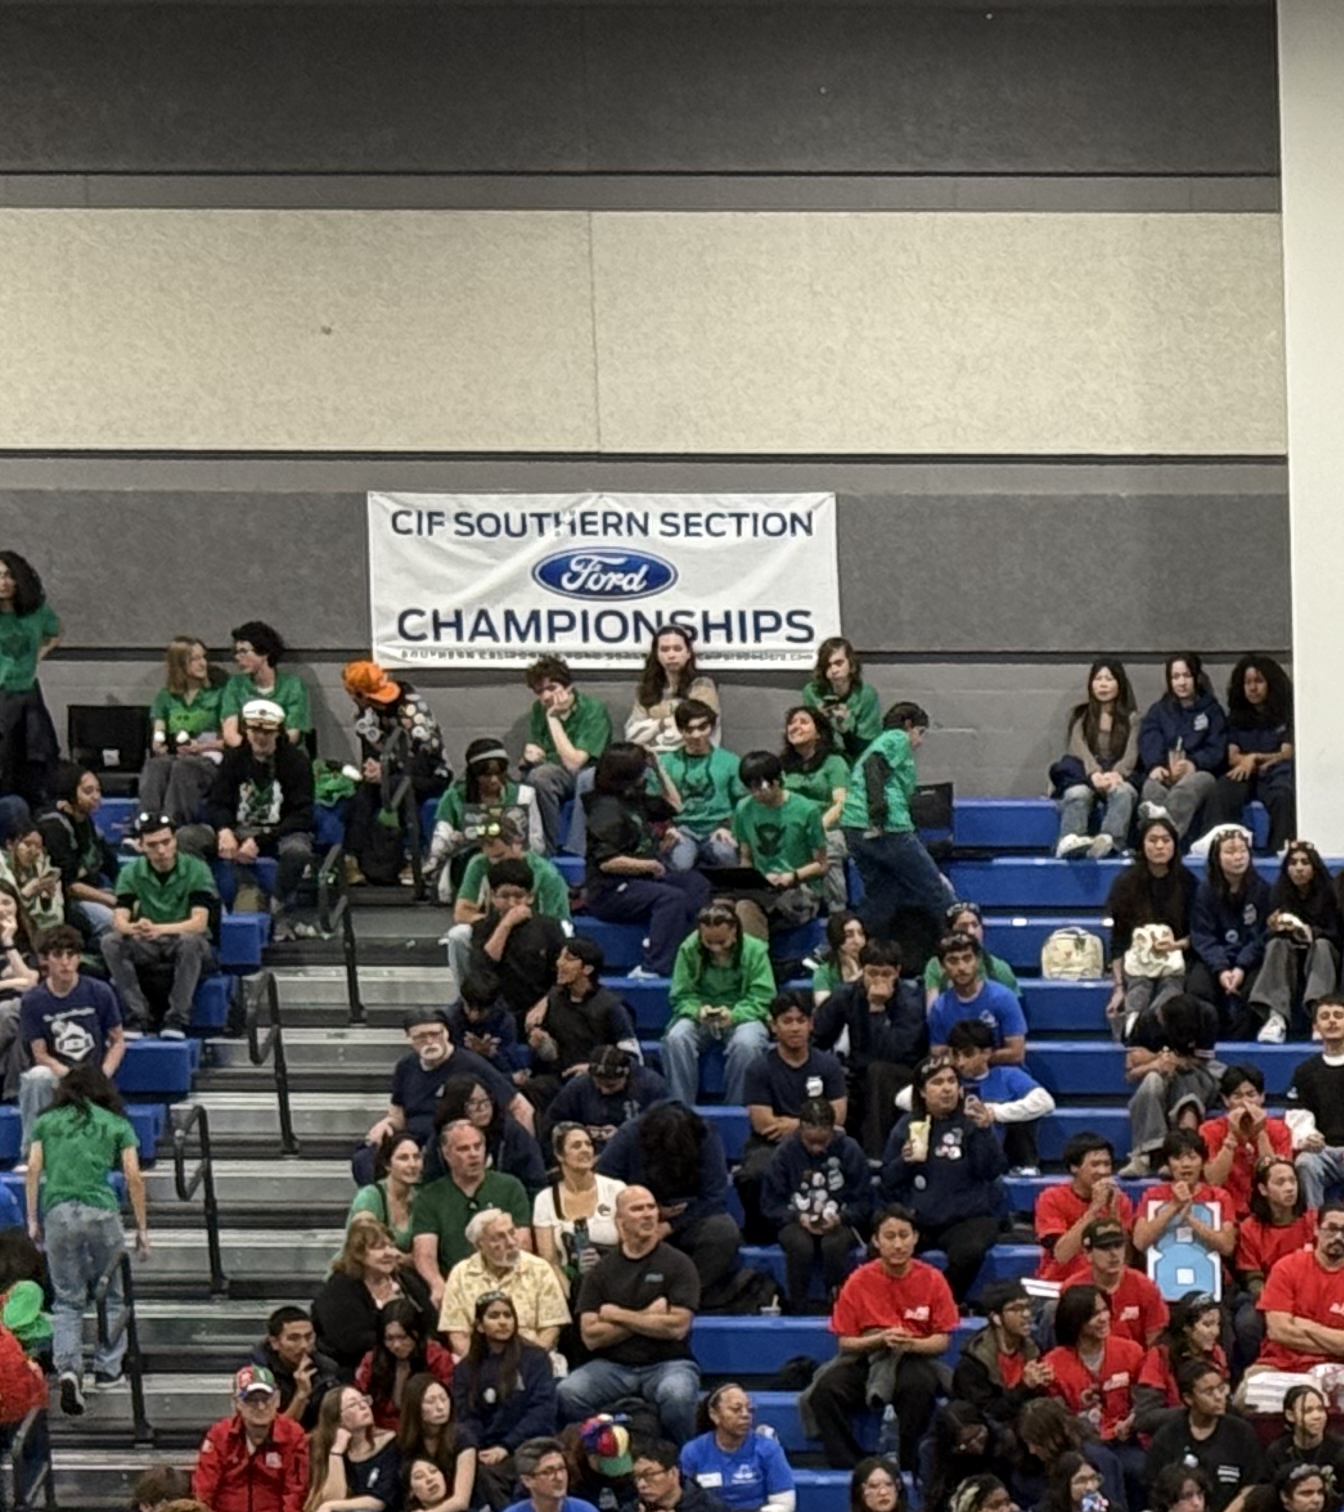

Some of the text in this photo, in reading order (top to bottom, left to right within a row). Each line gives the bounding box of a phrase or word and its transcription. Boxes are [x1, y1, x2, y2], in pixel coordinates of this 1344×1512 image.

[391, 509, 815, 538] CIF SOUTHERN SECTION
[560, 554, 648, 595] Ford
[397, 608, 816, 644] CHAMPIONSHIPS
